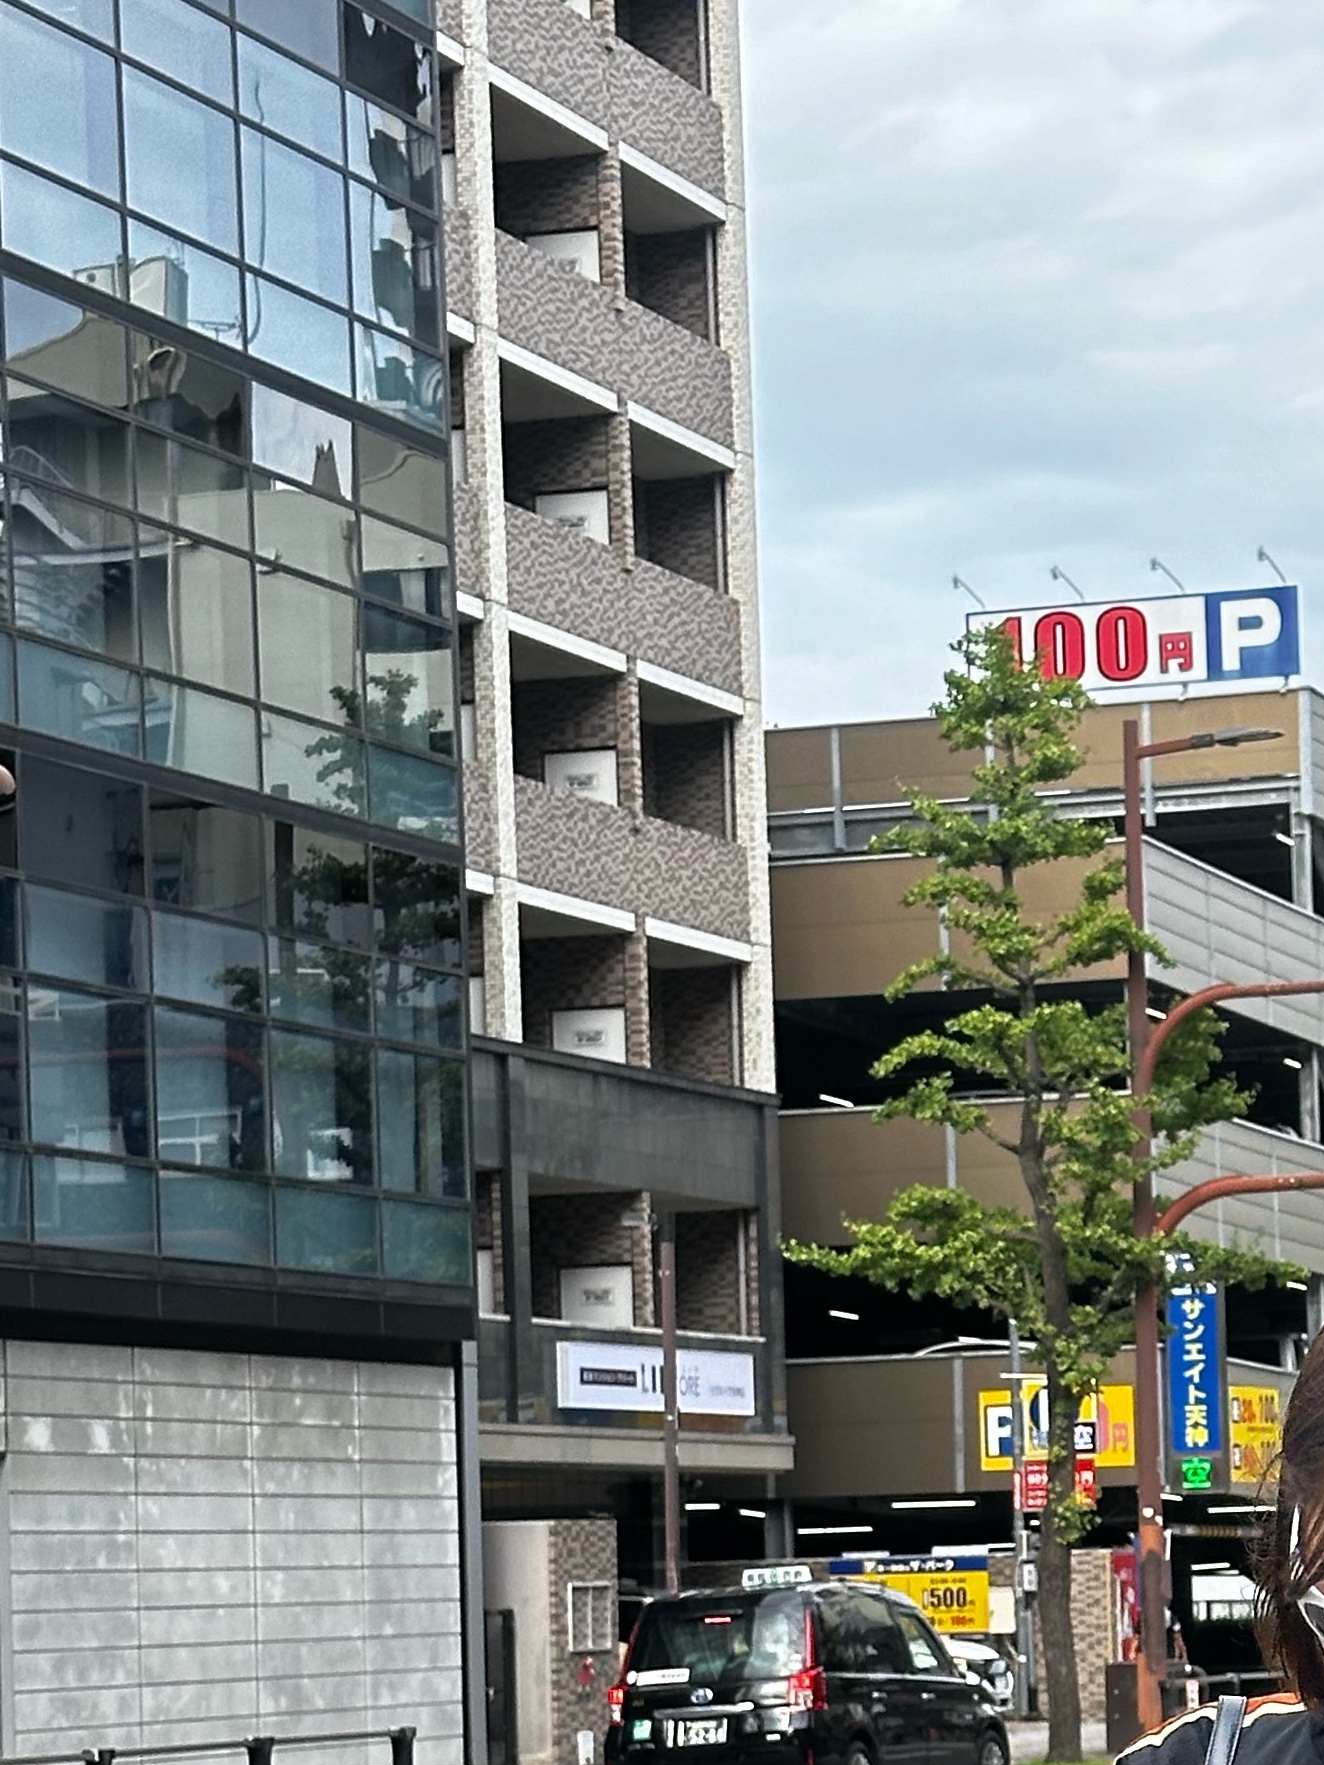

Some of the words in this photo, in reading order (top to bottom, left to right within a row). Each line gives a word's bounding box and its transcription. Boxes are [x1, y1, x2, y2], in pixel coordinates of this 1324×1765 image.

[1220, 597, 1282, 671] P
[1181, 1298, 1209, 1448] サンエイト天神
